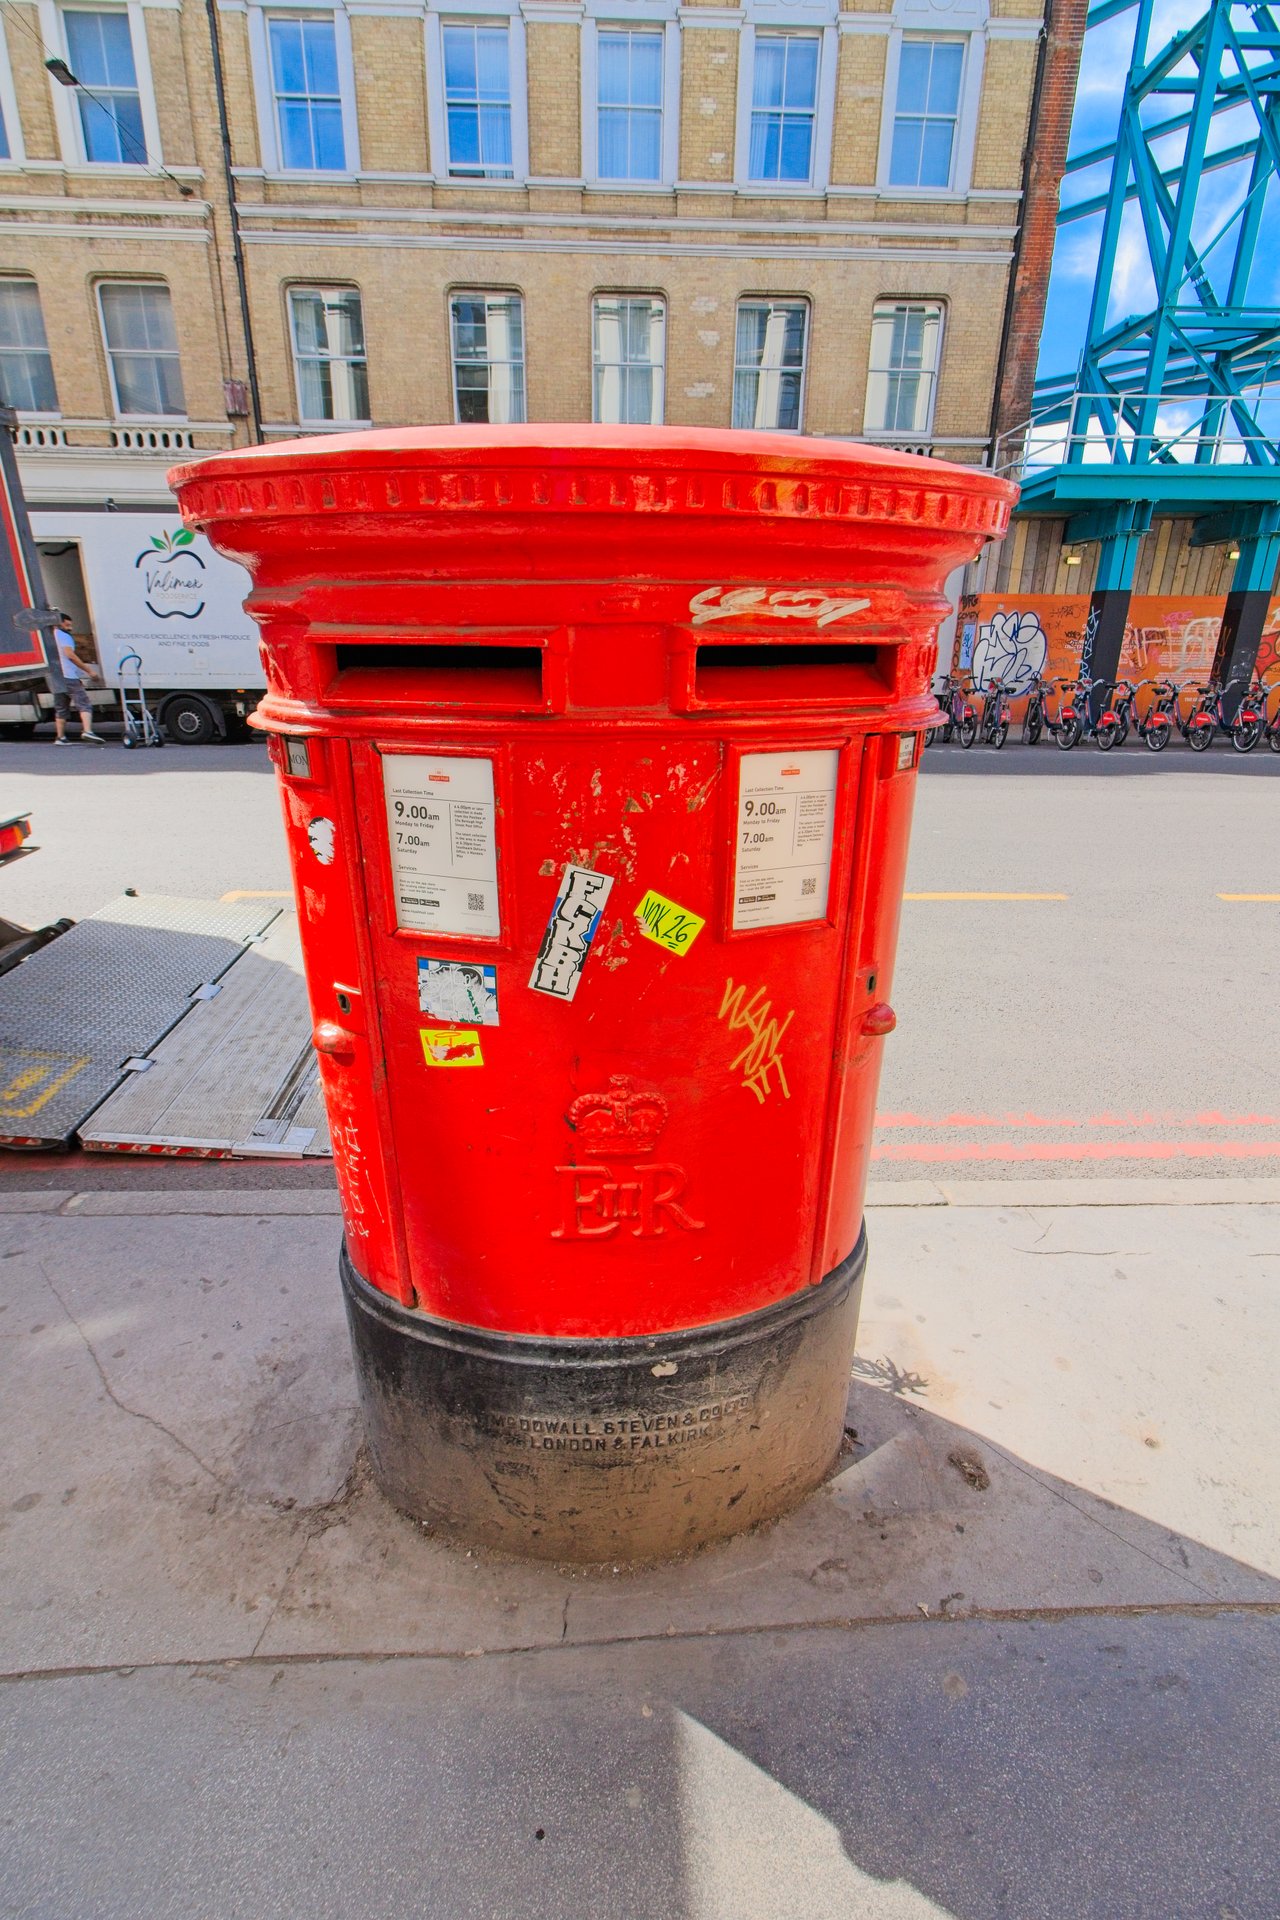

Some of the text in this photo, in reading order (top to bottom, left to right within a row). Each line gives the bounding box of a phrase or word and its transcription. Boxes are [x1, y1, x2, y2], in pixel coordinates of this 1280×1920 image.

[146, 570, 203, 594] Valimex
[394, 801, 440, 821] 9.00am
[745, 800, 786, 817] 9.00am
[396, 832, 430, 847] 7.00am
[742, 832, 774, 844] 7.00am
[682, 1412, 694, 1424] &
[530, 1427, 710, 1452] LONDON & FALKIRK
